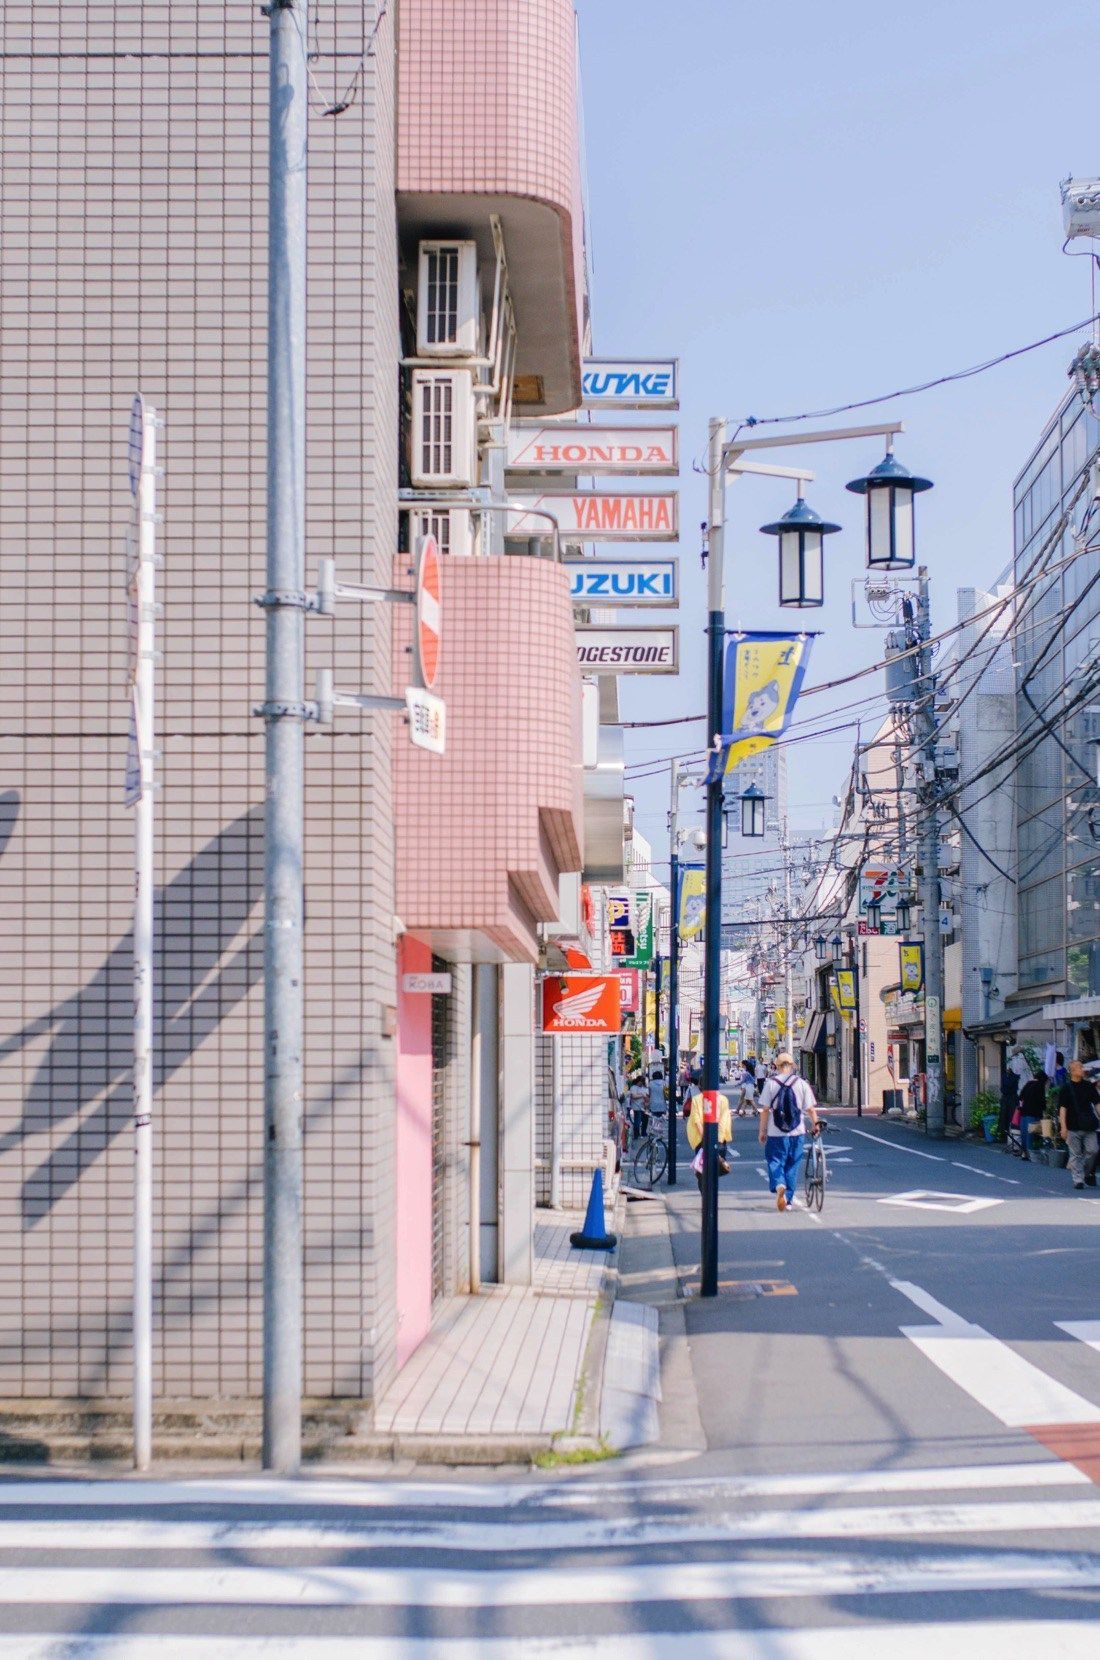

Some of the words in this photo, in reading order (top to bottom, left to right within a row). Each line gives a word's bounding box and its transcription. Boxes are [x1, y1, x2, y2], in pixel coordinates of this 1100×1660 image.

[533, 445, 670, 462] HONDA
[572, 498, 671, 530] YAMAHA
[553, 1018, 607, 1027] HONDA
